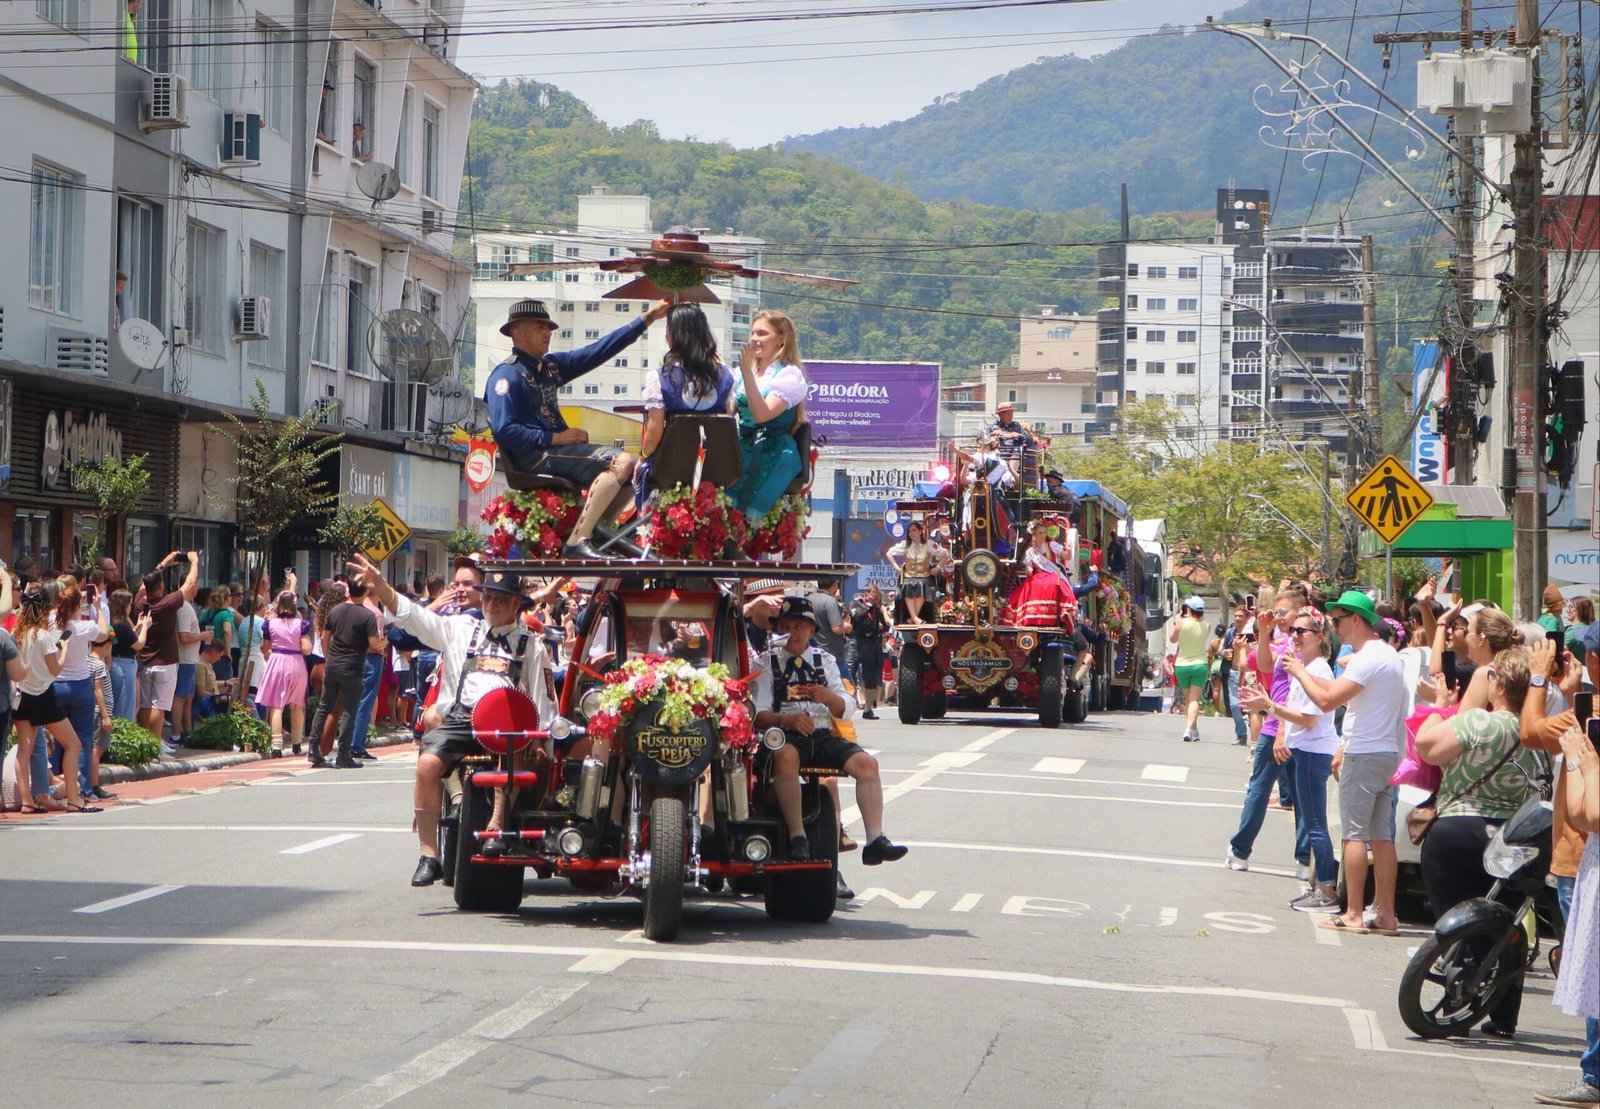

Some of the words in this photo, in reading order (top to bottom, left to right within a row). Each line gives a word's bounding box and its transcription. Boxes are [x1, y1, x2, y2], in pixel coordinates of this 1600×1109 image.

[430, 388, 462, 398] vivo
[822, 410, 847, 419] chegou
[815, 418, 829, 426] seja
[830, 418, 871, 426] bem-vindo!
